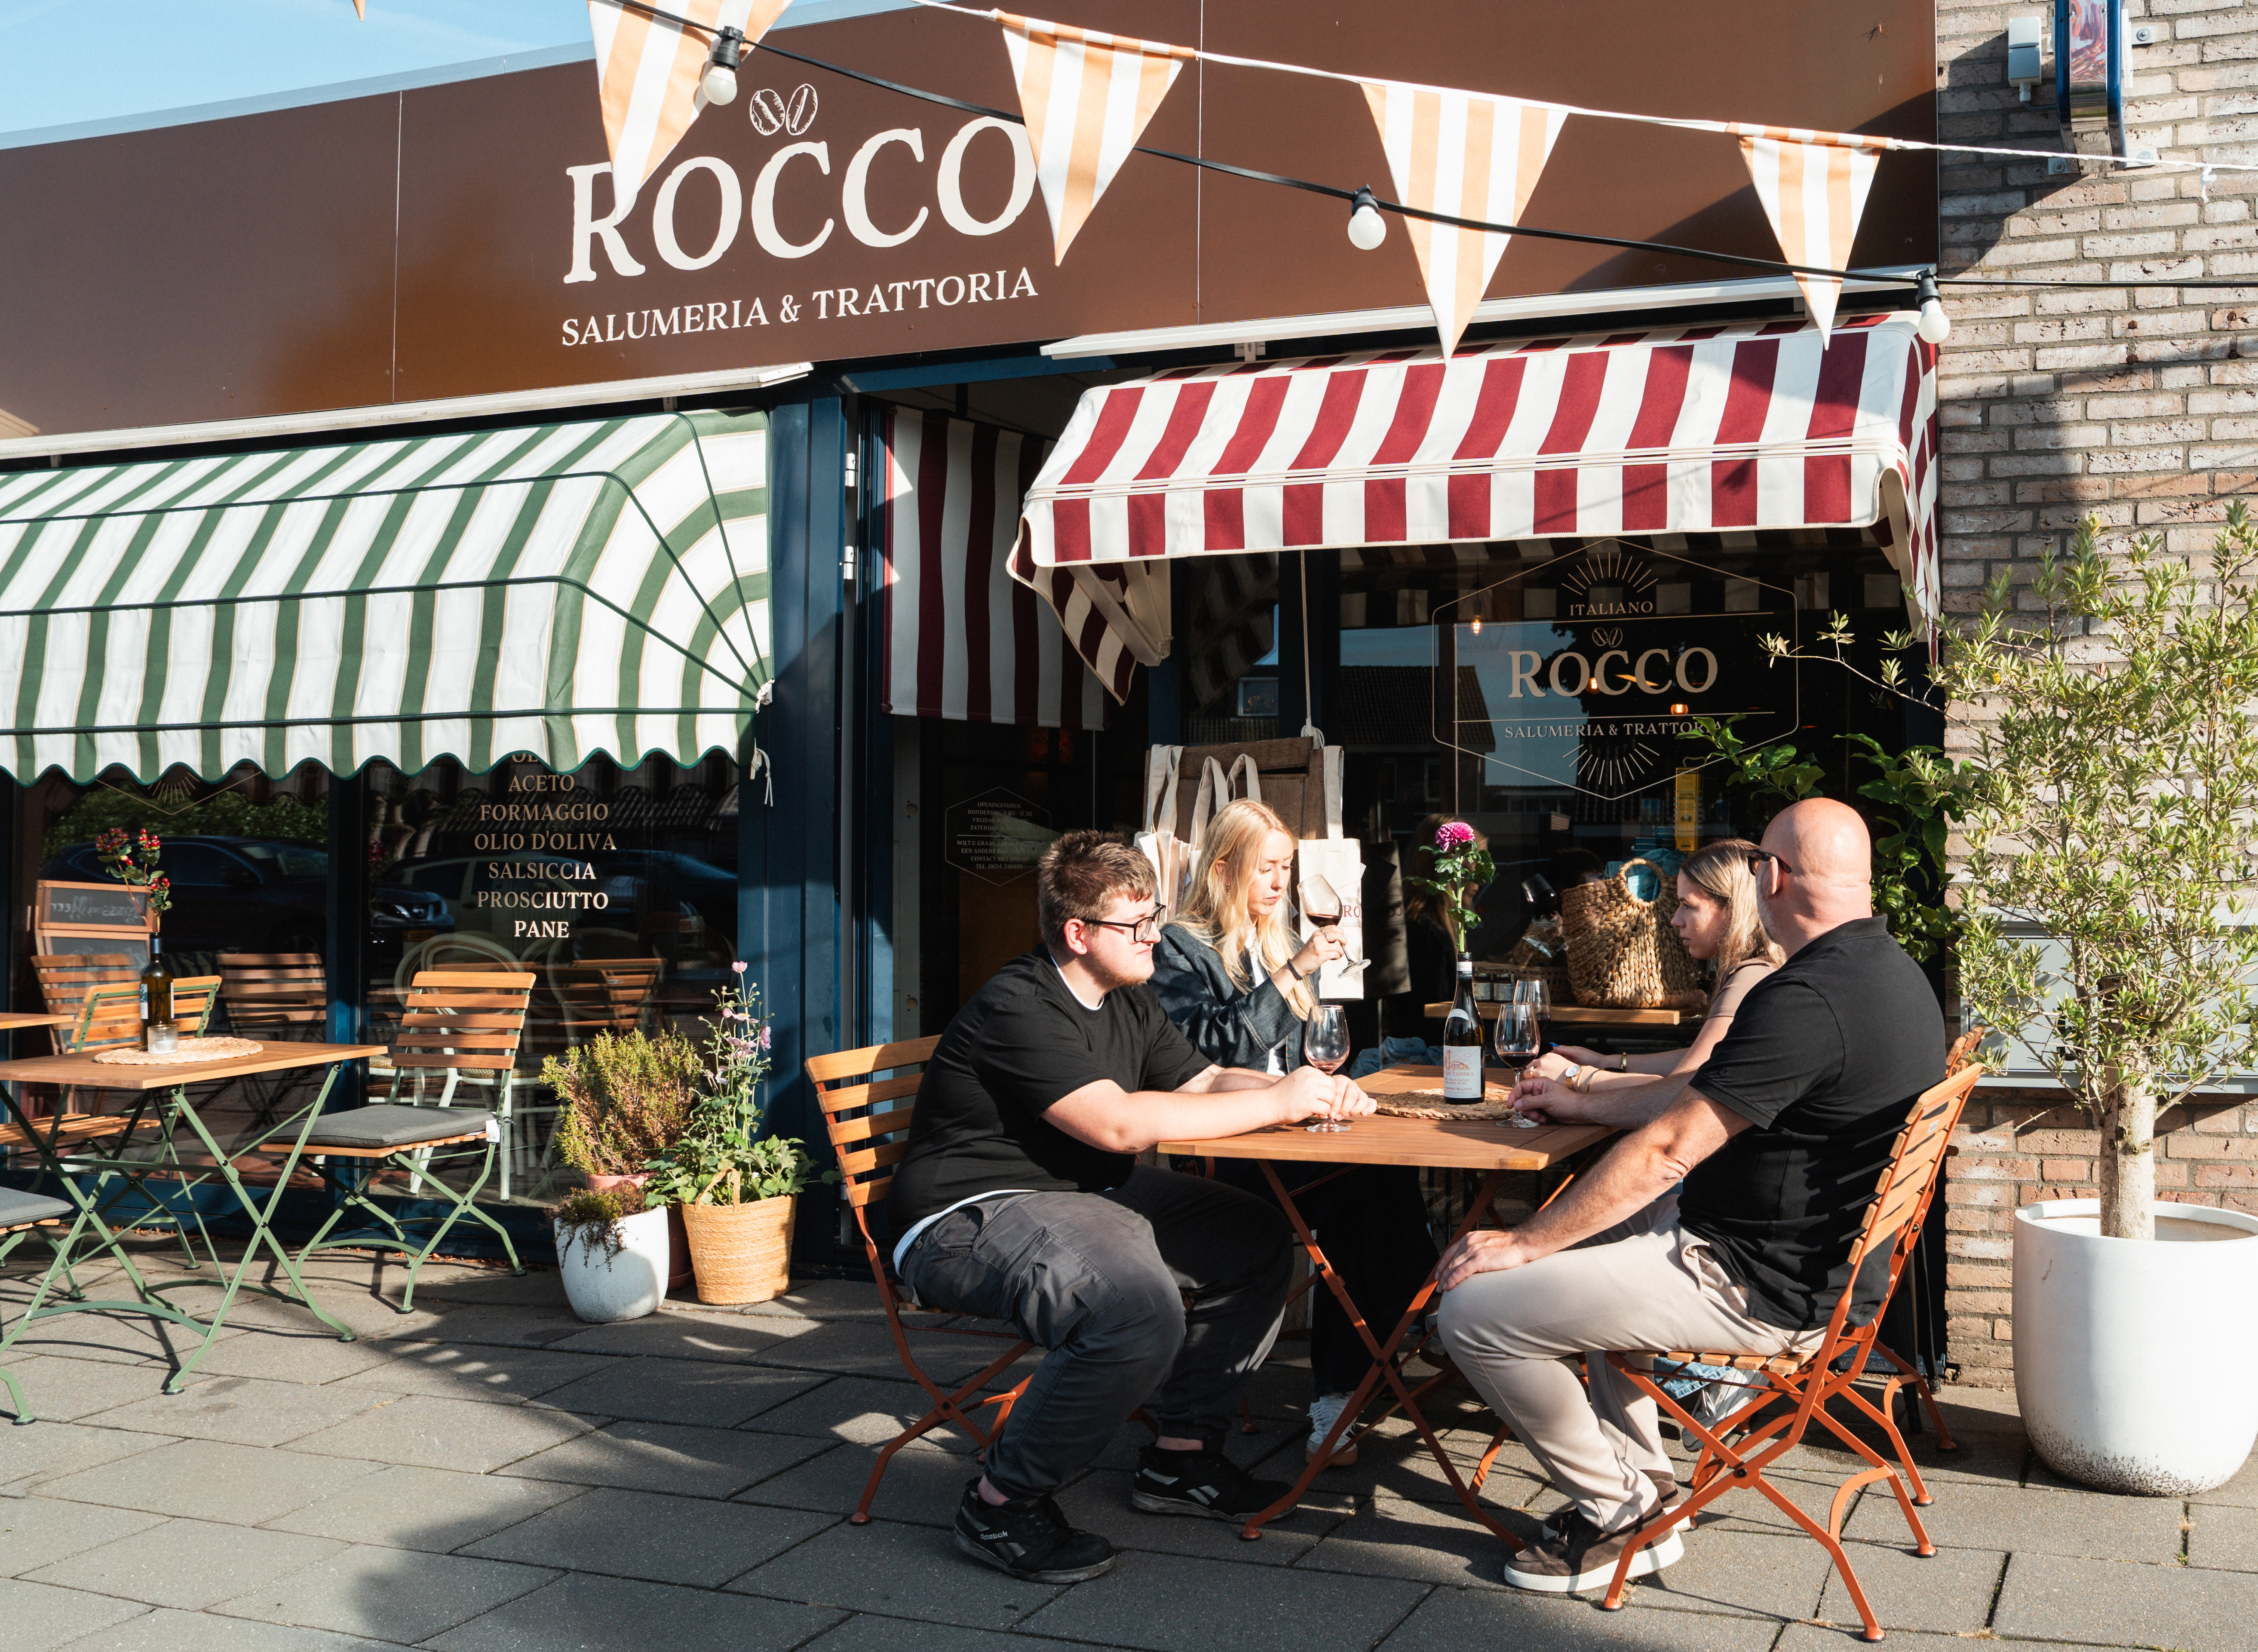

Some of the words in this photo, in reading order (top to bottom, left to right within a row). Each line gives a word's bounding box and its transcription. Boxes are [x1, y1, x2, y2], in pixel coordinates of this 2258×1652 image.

[564, 115, 1038, 284] ROCCO
[561, 296, 769, 347] SALUMERIA
[780, 294, 802, 323] &
[812, 267, 1038, 320] TRATTORIA
[1569, 601, 1654, 616] ITALIANO
[1508, 647, 1718, 699] ROCCO
[1505, 723, 1604, 739] SALUMERIA
[1609, 724, 1618, 736] &
[508, 775, 574, 792] ACETO
[481, 803, 609, 821] FORMAGGIO
[475, 834, 524, 850] OLIO
[532, 831, 617, 850] D'OLIVA
[489, 863, 597, 880] SALSICCIA
[478, 892, 609, 909] PROSCIUTTO
[1343, 905, 1362, 917] RO
[514, 921, 569, 938] PANE
[980, 1531, 1008, 1541] Reebok
